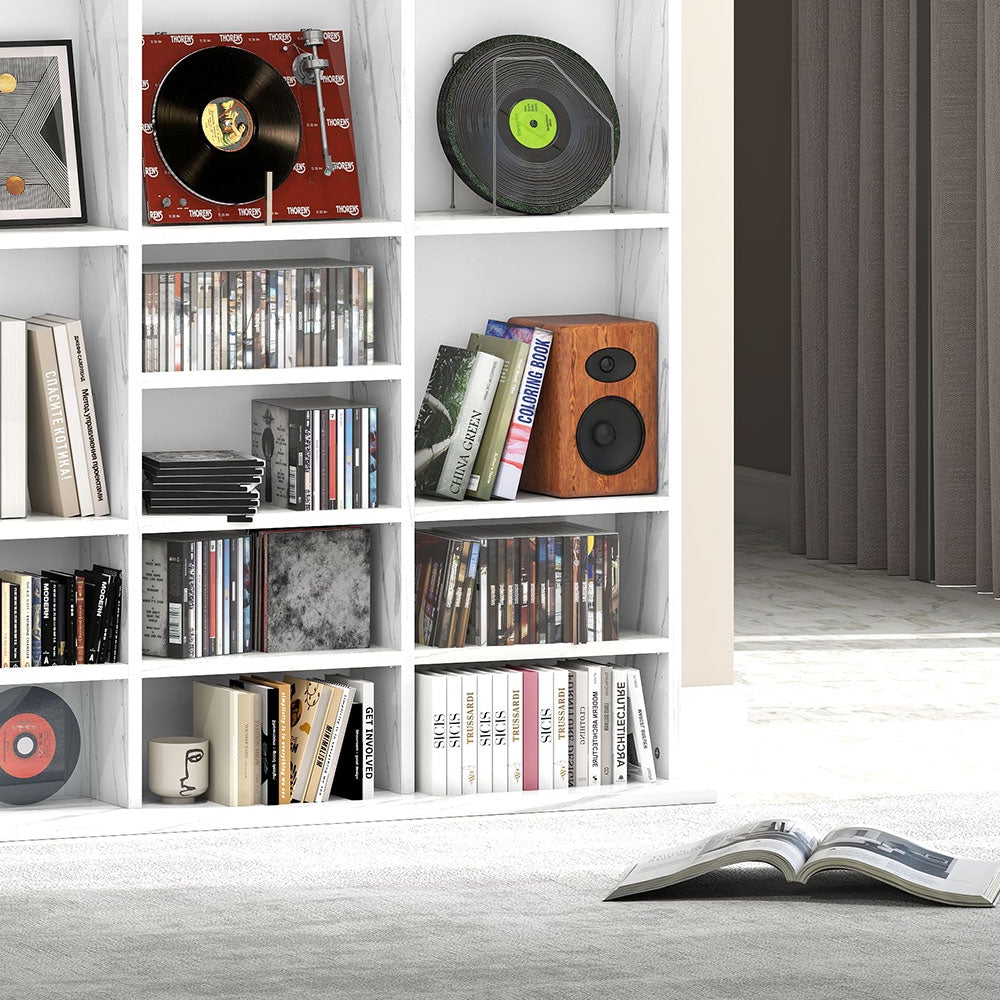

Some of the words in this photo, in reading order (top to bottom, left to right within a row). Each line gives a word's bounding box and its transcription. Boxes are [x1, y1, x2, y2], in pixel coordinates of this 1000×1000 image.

[170, 35, 194, 46] THORENS
[220, 33, 243, 44] THORENS
[269, 33, 292, 43] THORENS
[323, 31, 340, 42] ORENS
[142, 123, 153, 134] RENS
[327, 118, 349, 129] THORENS
[144, 167, 158, 178] RENS
[150, 210, 163, 221] RENS
[189, 209, 212, 220] THORENS
[238, 208, 261, 218] THORENS
[287, 207, 310, 217] THORENS
[336, 205, 359, 216] THORENS
[45, 371, 62, 425] СПАСИТЕ
[517, 371, 542, 424] COLORING
[531, 337, 550, 369] BOOK
[82, 389, 92, 412] Метод
[52, 428, 72, 481] КОТИКА!
[84, 412, 97, 461] управления
[450, 454, 470, 494] CHINA
[462, 410, 482, 451] GREEN
[96, 581, 107, 617] MODERN
[365, 707, 373, 725] GET
[434, 713, 445, 749] SICIS
[449, 712, 460, 748] SICIS
[466, 692, 474, 745] TRUSSARDI
[480, 711, 491, 747] SICIS
[495, 710, 506, 746] SICIS
[541, 708, 552, 743] SICIS
[316, 724, 333, 768] MINIMALISM
[365, 728, 373, 779] INVOLVED
[281, 777, 286, 786] we
